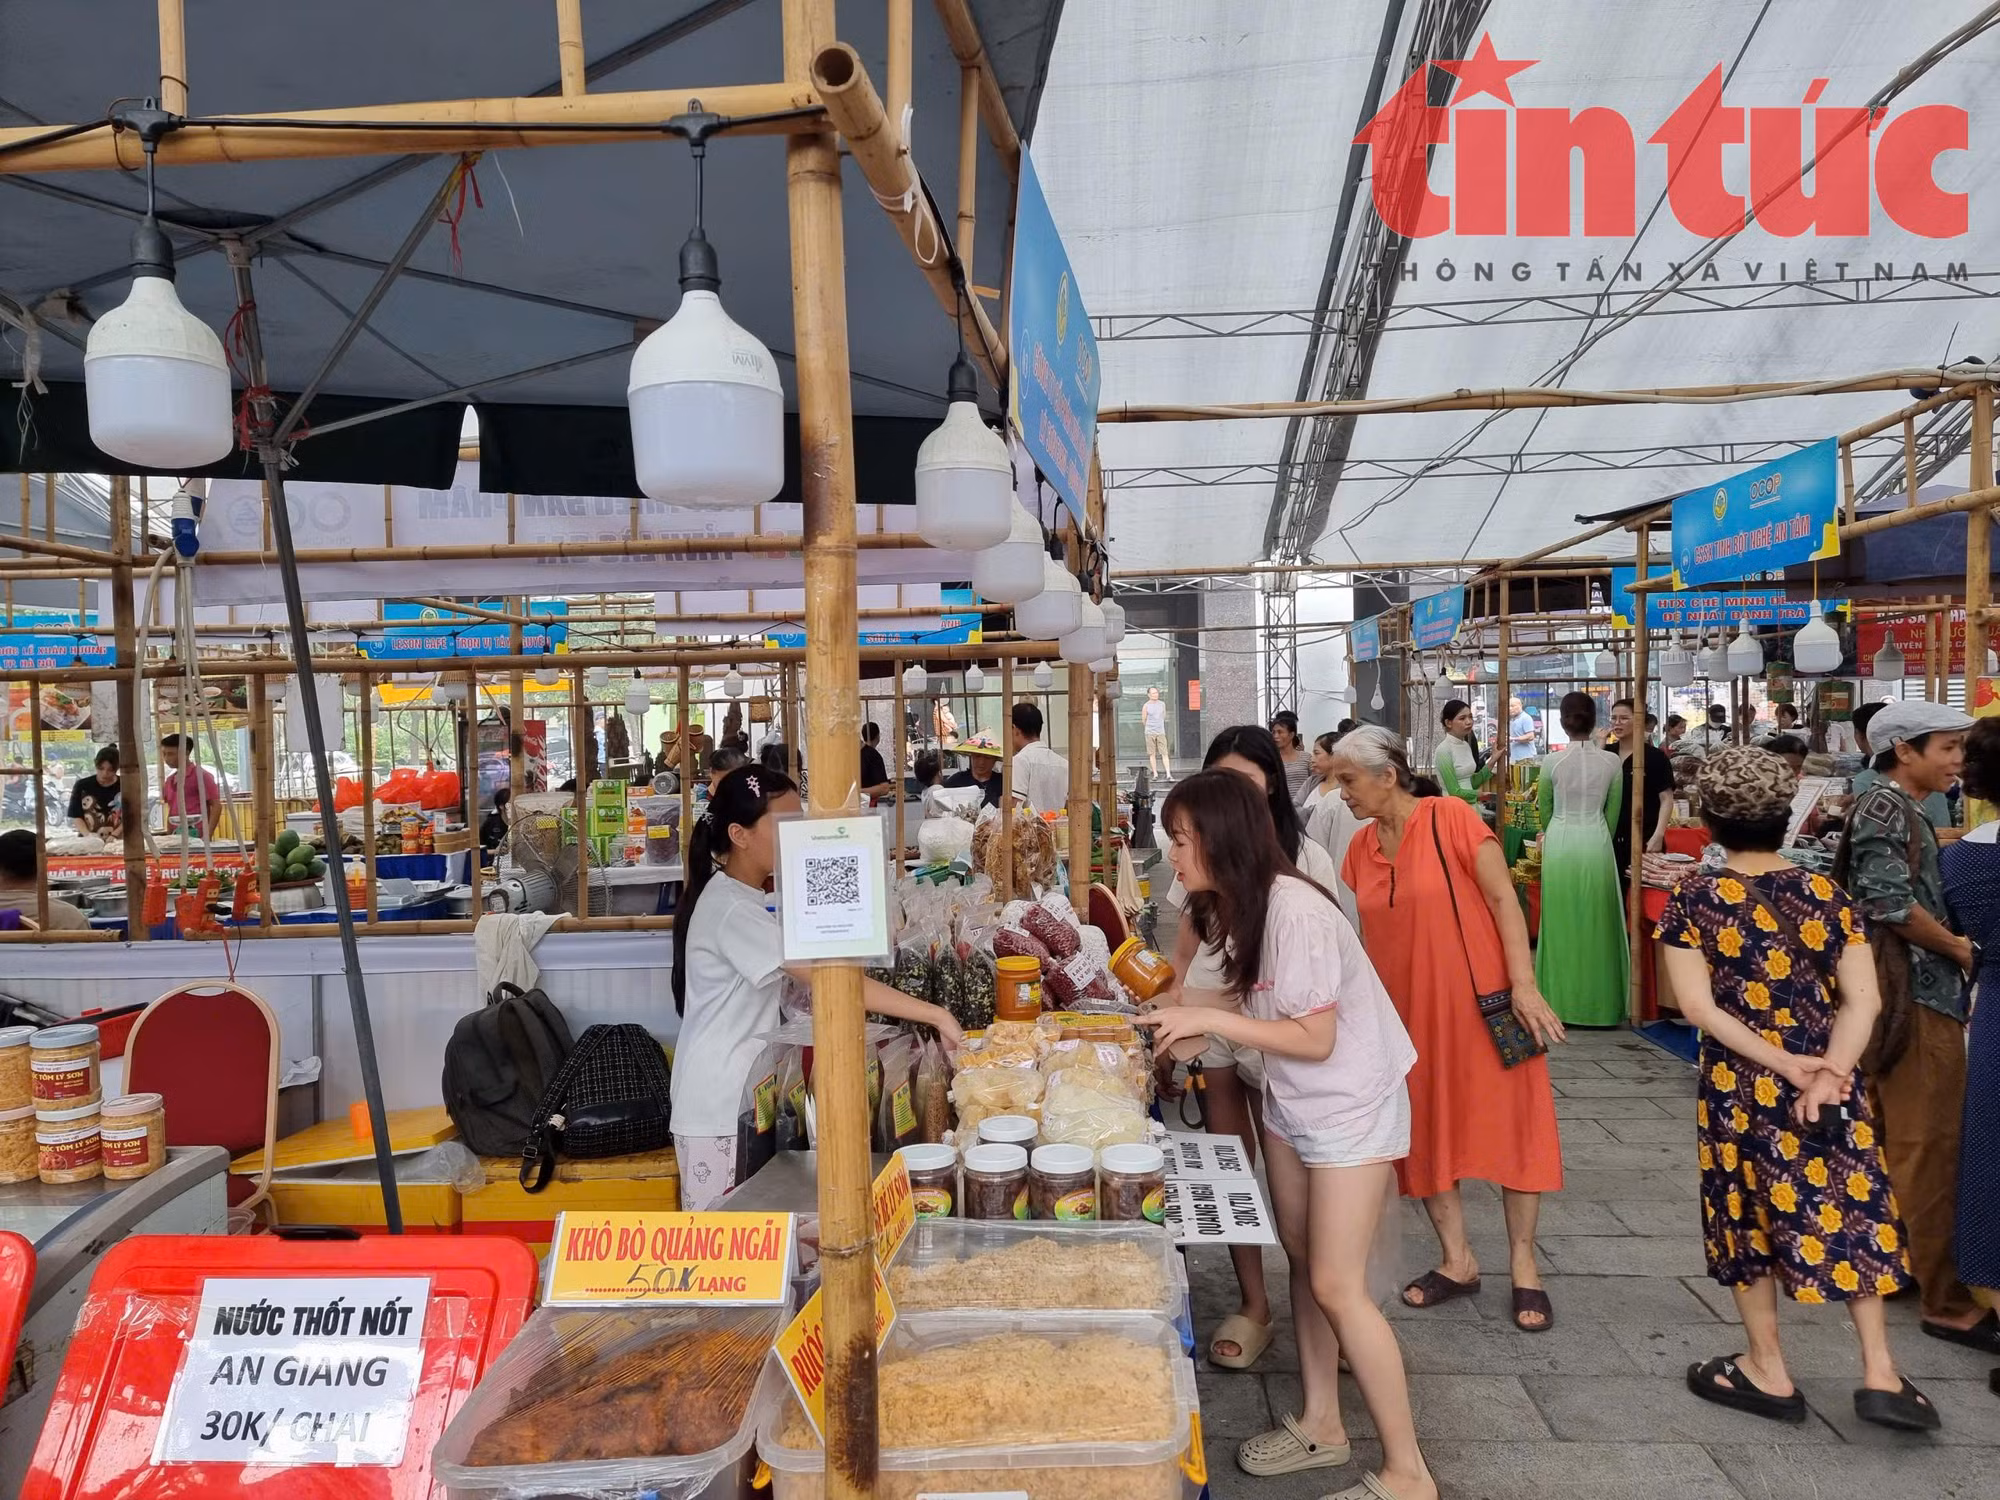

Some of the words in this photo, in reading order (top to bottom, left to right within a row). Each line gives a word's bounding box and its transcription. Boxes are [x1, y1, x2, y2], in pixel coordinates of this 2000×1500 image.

[1750, 472, 1782, 501] OCOP
[1733, 529, 1748, 557] BỘT
[1750, 521, 1773, 551] NGHỆ
[1773, 522, 1787, 543] AN
[1789, 513, 1811, 539] TÂM
[1658, 598, 1686, 609] HTX
[1725, 595, 1765, 607] MINH
[1779, 608, 1806, 619] TRÀ
[391, 637, 423, 650] LESON
[39, 1073, 54, 1081] TÔM
[56, 1072, 65, 1080] LÝ
[66, 1071, 84, 1079] SƠN
[56, 1143, 73, 1152] TÔM
[114, 1140, 122, 1149] LÝ
[123, 1139, 141, 1148] SƠN
[1180, 1142, 1201, 1160] GIANG
[1184, 1160, 1204, 1170] AN
[1188, 1203, 1226, 1236] QUẢNG
[565, 1220, 612, 1261] KHÔ
[615, 1220, 646, 1261] BÒ
[650, 1216, 724, 1265] QUẢNG
[728, 1219, 781, 1261] NGÃI
[213, 1298, 284, 1336] NƯỚC
[292, 1295, 355, 1336] THỐT
[359, 1296, 413, 1336] NỐT
[209, 1356, 265, 1387] AN
[273, 1355, 391, 1388] GIANG
[200, 1408, 282, 1448] 30K/
[288, 1411, 371, 1443] CHAI
